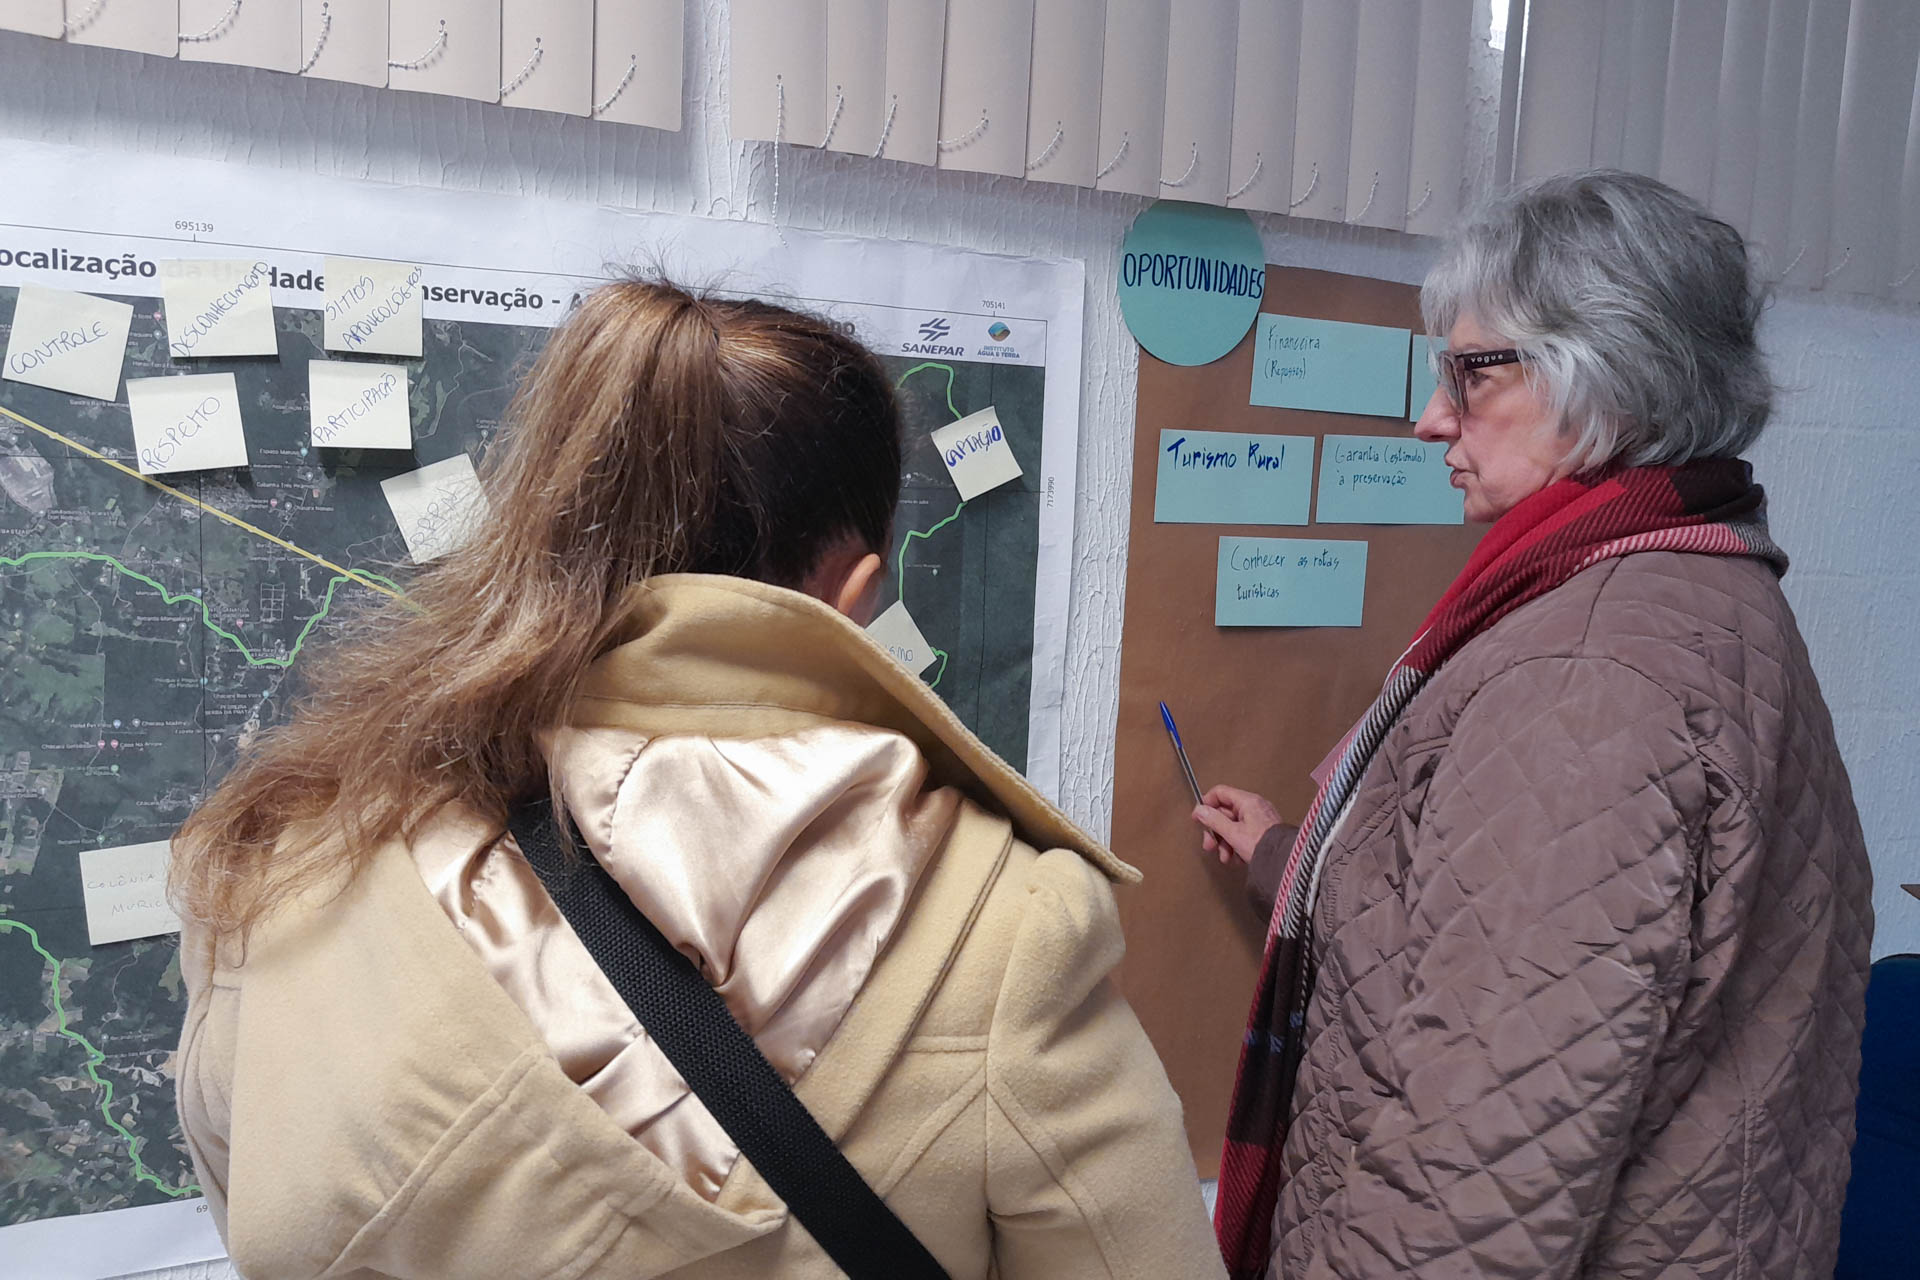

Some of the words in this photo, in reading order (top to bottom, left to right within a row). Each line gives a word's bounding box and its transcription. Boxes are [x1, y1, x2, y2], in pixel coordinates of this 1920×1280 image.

[175, 220, 214, 233] 695139
[1123, 252, 1265, 300] OPORTUNIDADES
[982, 300, 1006, 310] 705141
[10, 321, 109, 374] CONTROLE
[901, 342, 965, 357] SANEPAR
[984, 345, 1015, 353] INSTITUTO
[1268, 324, 1321, 351] Financeira
[312, 371, 398, 444] PARTICIPAÇÃO
[140, 396, 221, 471] RESPEITO
[1167, 437, 1237, 470] Turismo
[1247, 441, 1285, 471] Rural
[1335, 443, 1380, 464] Garantia
[1047, 476, 1055, 508] 7173990
[1353, 470, 1408, 491] preservação
[1230, 545, 1286, 571] Conhecer
[1297, 555, 1308, 568] as
[1313, 548, 1340, 571] rotas
[87, 874, 154, 889] COLÔNIA
